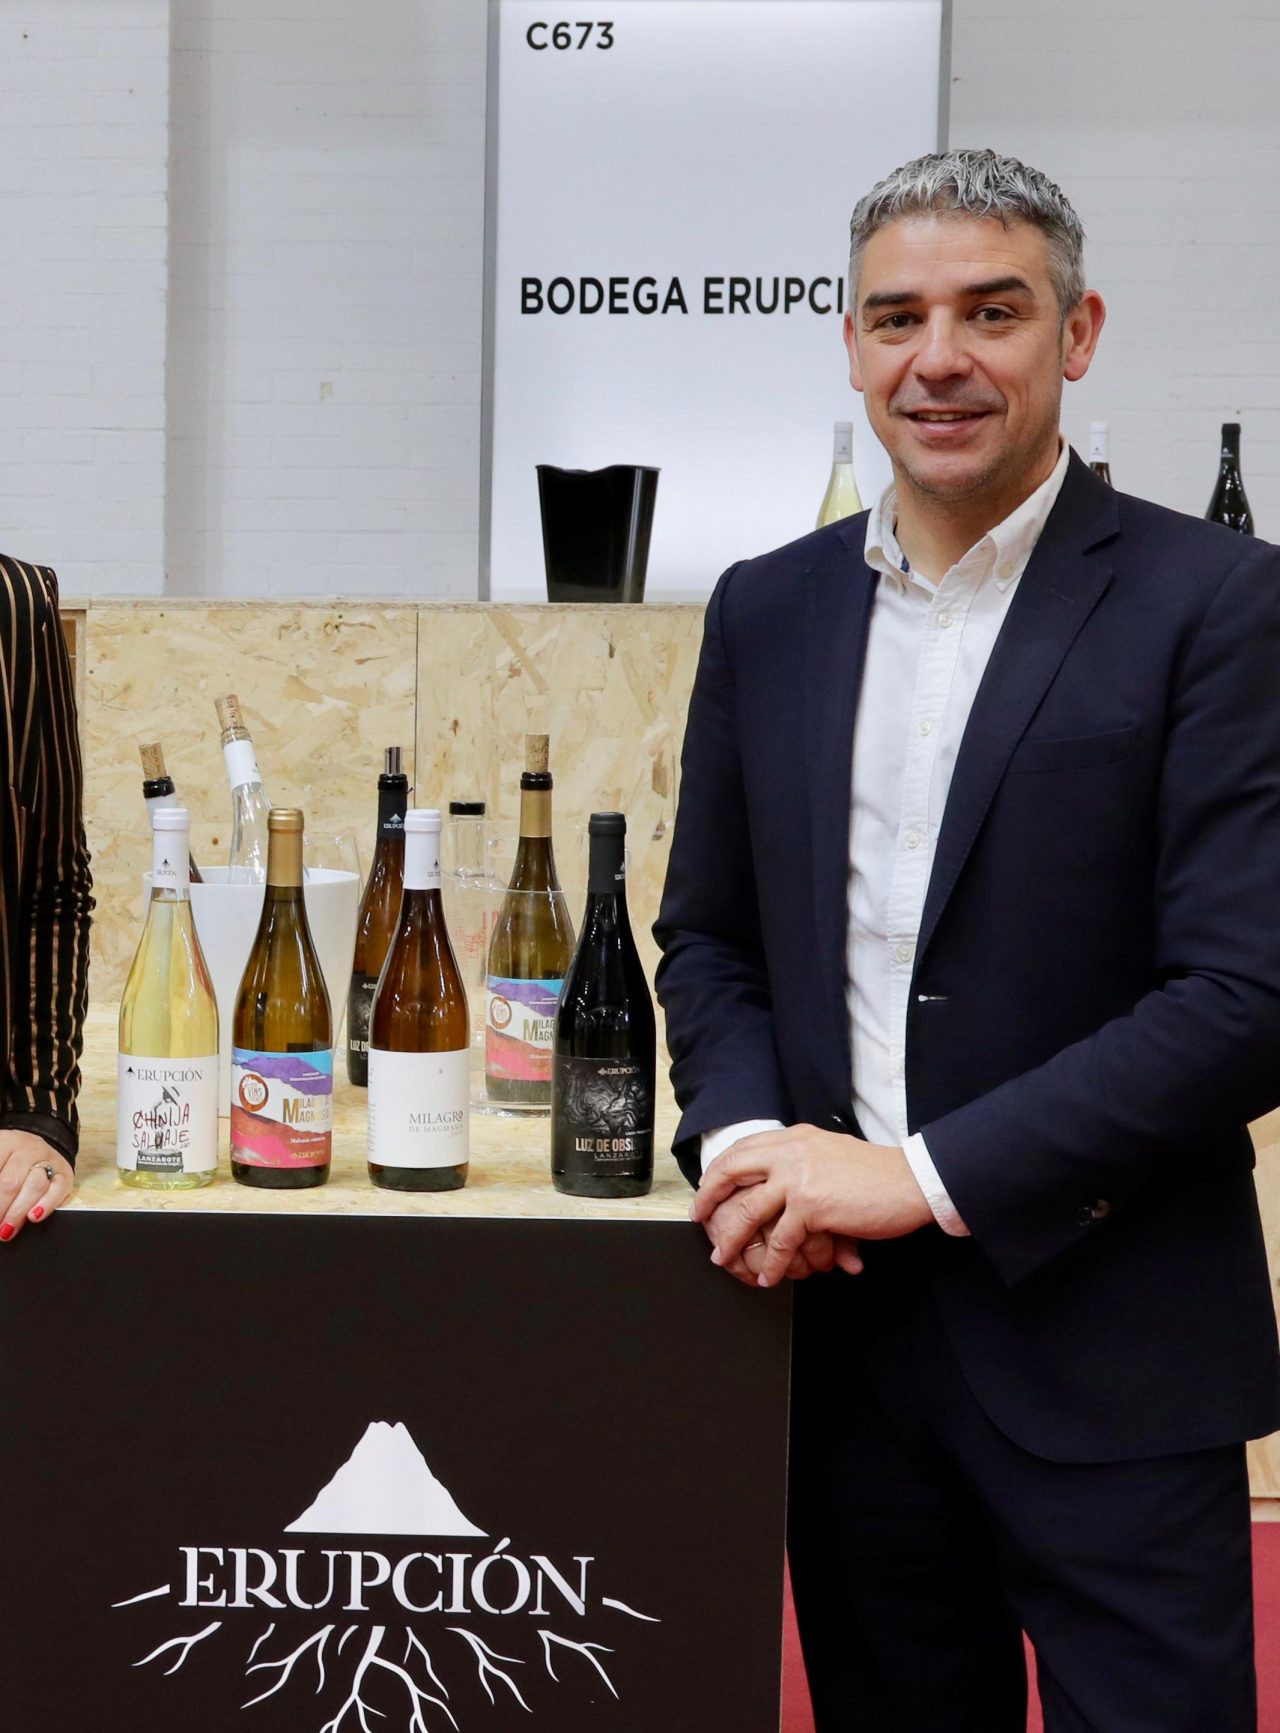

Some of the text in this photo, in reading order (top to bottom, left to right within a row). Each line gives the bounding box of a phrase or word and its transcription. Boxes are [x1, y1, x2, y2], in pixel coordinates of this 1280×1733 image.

[526, 21, 615, 50] C673
[521, 277, 688, 314] BODEGA
[137, 1068, 203, 1082] ERUPCIÓN
[409, 1110, 464, 1124] MILAGRO
[576, 1137, 594, 1152] LUZ
[596, 1138, 610, 1152] DE
[178, 1537, 594, 1616] ERUPCIÓN
